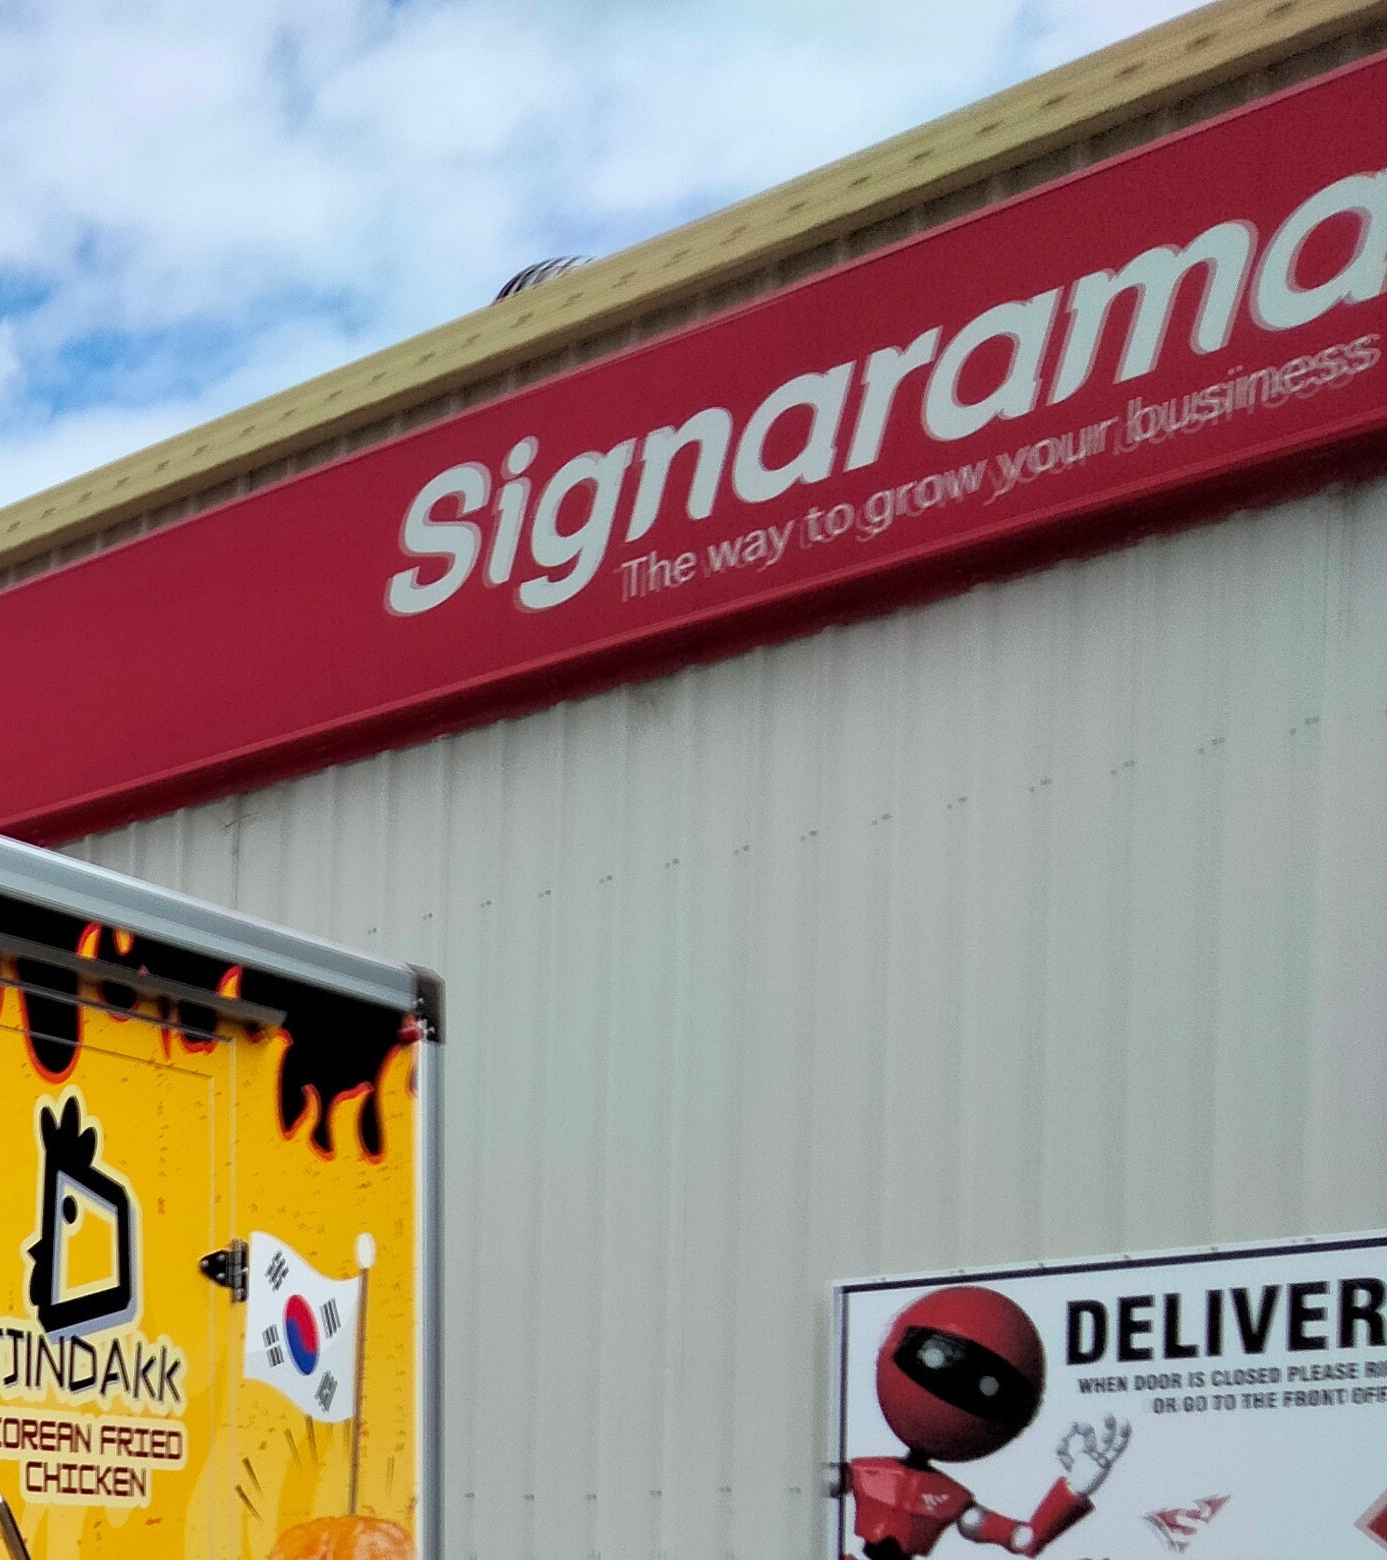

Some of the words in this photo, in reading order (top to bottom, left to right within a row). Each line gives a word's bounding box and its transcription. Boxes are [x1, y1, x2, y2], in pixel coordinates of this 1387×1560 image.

[387, 167, 1387, 613] Signarama
[619, 550, 698, 600] The
[704, 518, 796, 577] way
[802, 500, 855, 548] to
[862, 463, 985, 541] grow
[988, 417, 1116, 501] your
[1119, 333, 1382, 452] business
[1066, 1277, 1387, 1365] DELIVER
[1078, 1376, 1127, 1393] WHEN
[1133, 1373, 1182, 1391] DOOR
[1188, 1371, 1205, 1388] IS
[1210, 1367, 1282, 1387] CLOSED
[1287, 1362, 1359, 1382] PLEASE
[1152, 1397, 1176, 1414] OR
[1183, 1395, 1207, 1412] GO
[1212, 1393, 1236, 1411] TO
[1241, 1391, 1276, 1410] THE
[1282, 1388, 1347, 1408] FRONT
[100, 1425, 183, 1460] FRIED
[26, 1461, 146, 1497] CHICKEN
